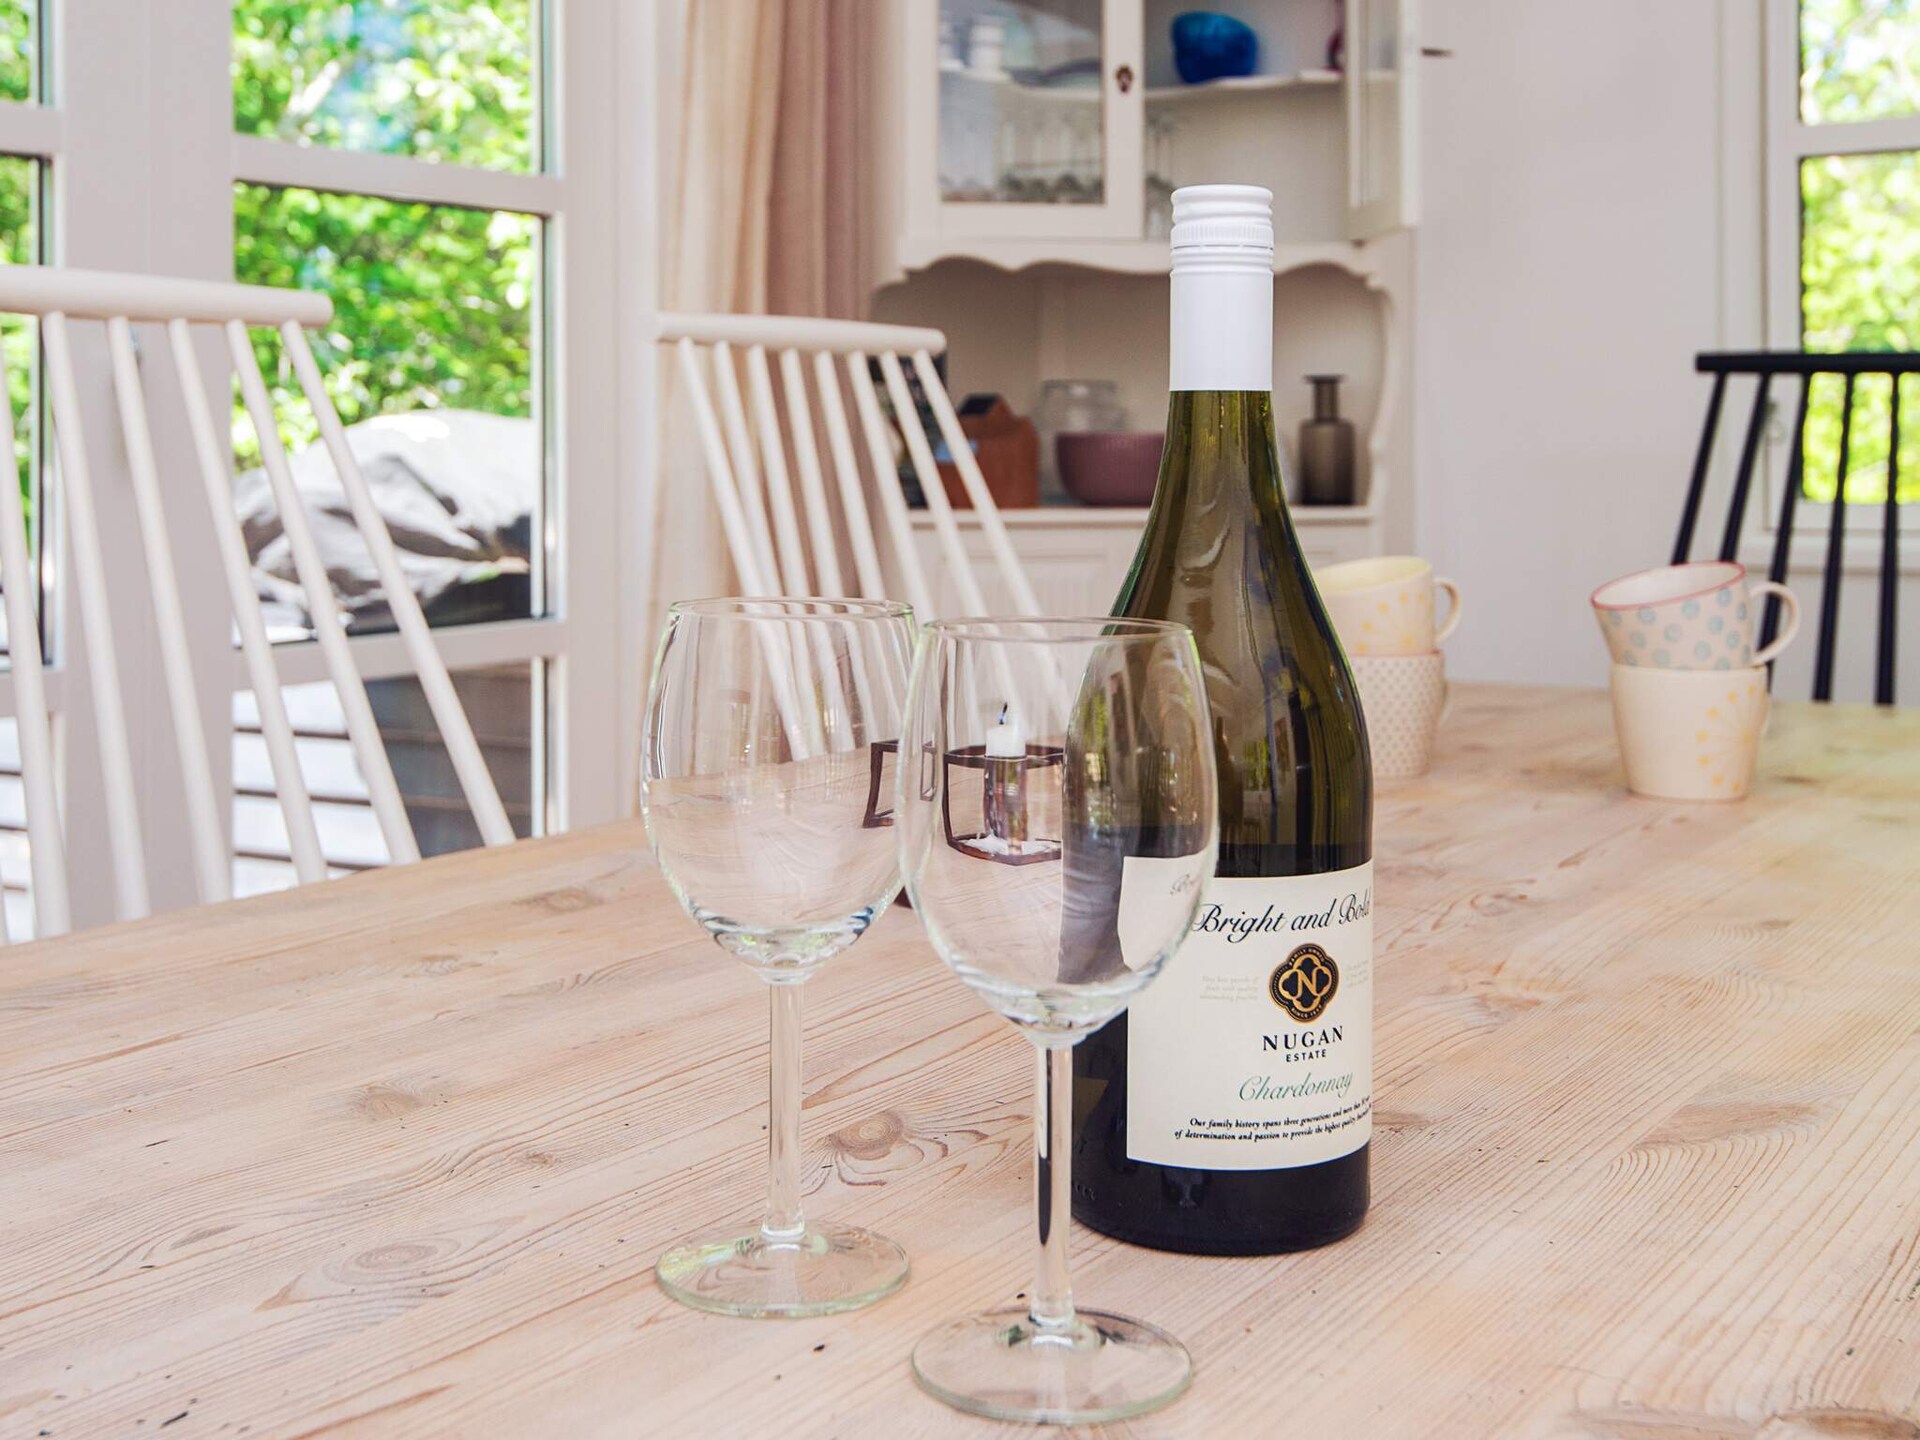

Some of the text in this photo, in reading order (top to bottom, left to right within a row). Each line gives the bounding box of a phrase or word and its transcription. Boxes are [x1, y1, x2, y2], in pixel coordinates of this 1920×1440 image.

[1192, 903, 1288, 944] Bright
[1291, 898, 1337, 931] and
[1262, 1025, 1343, 1051] NUGAN
[1286, 1049, 1327, 1063] ESTATE
[1239, 1072, 1353, 1101] Chardonnay
[1190, 1118, 1206, 1127] Our
[1207, 1118, 1232, 1130] family
[1235, 1119, 1260, 1130] history
[1262, 1120, 1281, 1130] spans
[1284, 1117, 1299, 1126] three
[1332, 1107, 1342, 1117] and
[1174, 1129, 1183, 1140] of
[1185, 1129, 1236, 1140] determination
[1238, 1131, 1252, 1140] and
[1254, 1132, 1280, 1142] passion
[1290, 1127, 1313, 1140] provide
[1315, 1124, 1323, 1134] the
